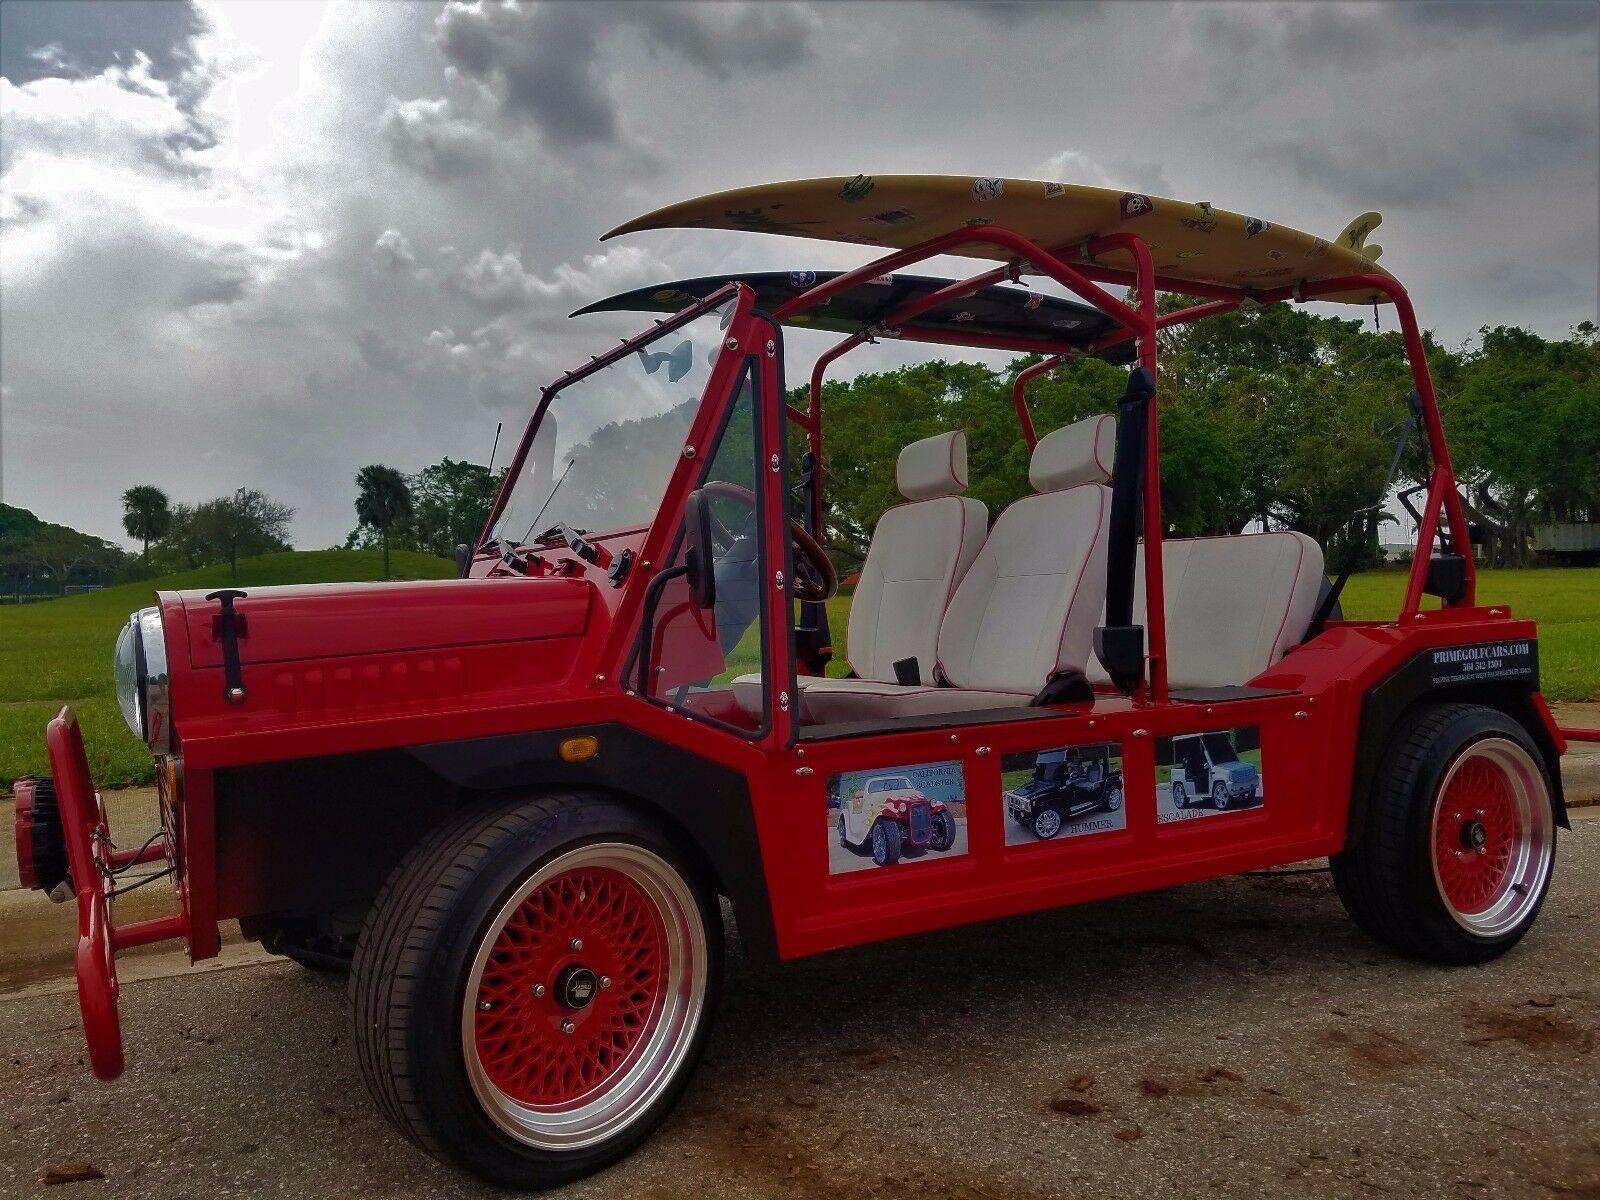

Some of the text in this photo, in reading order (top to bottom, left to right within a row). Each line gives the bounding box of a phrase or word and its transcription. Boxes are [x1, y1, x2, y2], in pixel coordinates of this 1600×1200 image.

[1434, 644, 1529, 663] PRIMEGOLFCARS.COM
[912, 767, 957, 778] CALIFORNIA
[1157, 809, 1204, 823] ESCALADE
[1071, 819, 1113, 833] HUMMER
